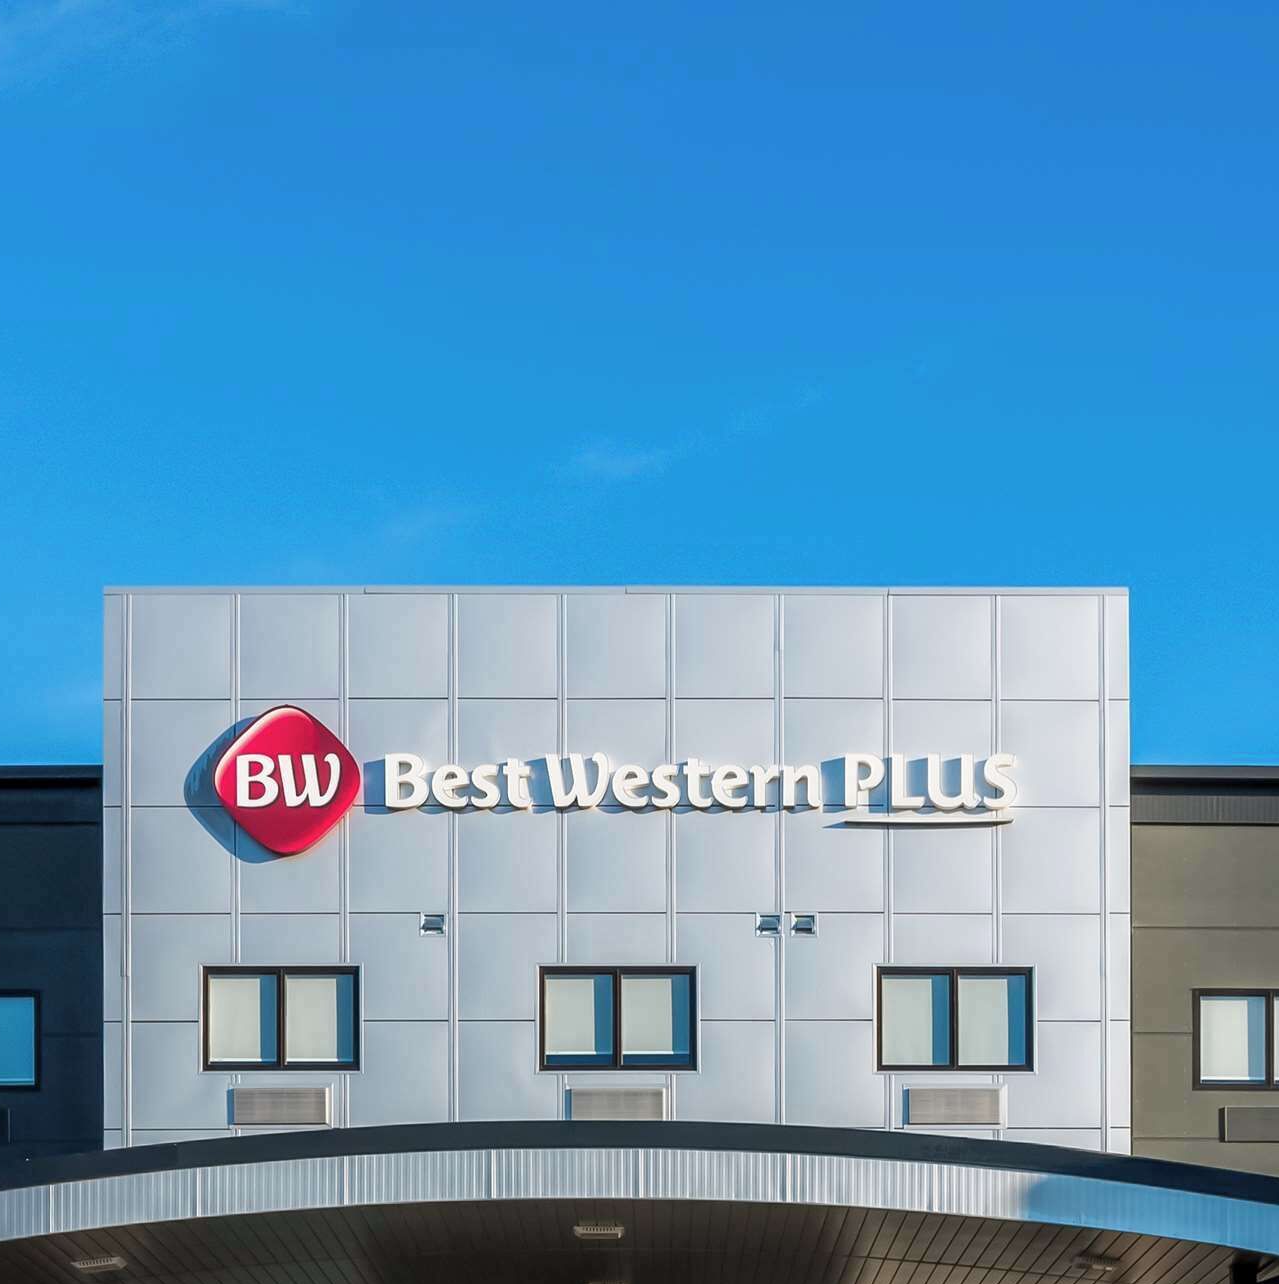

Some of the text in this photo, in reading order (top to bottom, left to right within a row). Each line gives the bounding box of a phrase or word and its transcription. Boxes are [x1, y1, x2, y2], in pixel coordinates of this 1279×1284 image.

[236, 753, 340, 808] BW
[385, 752, 1017, 810] Best Western PLUS
